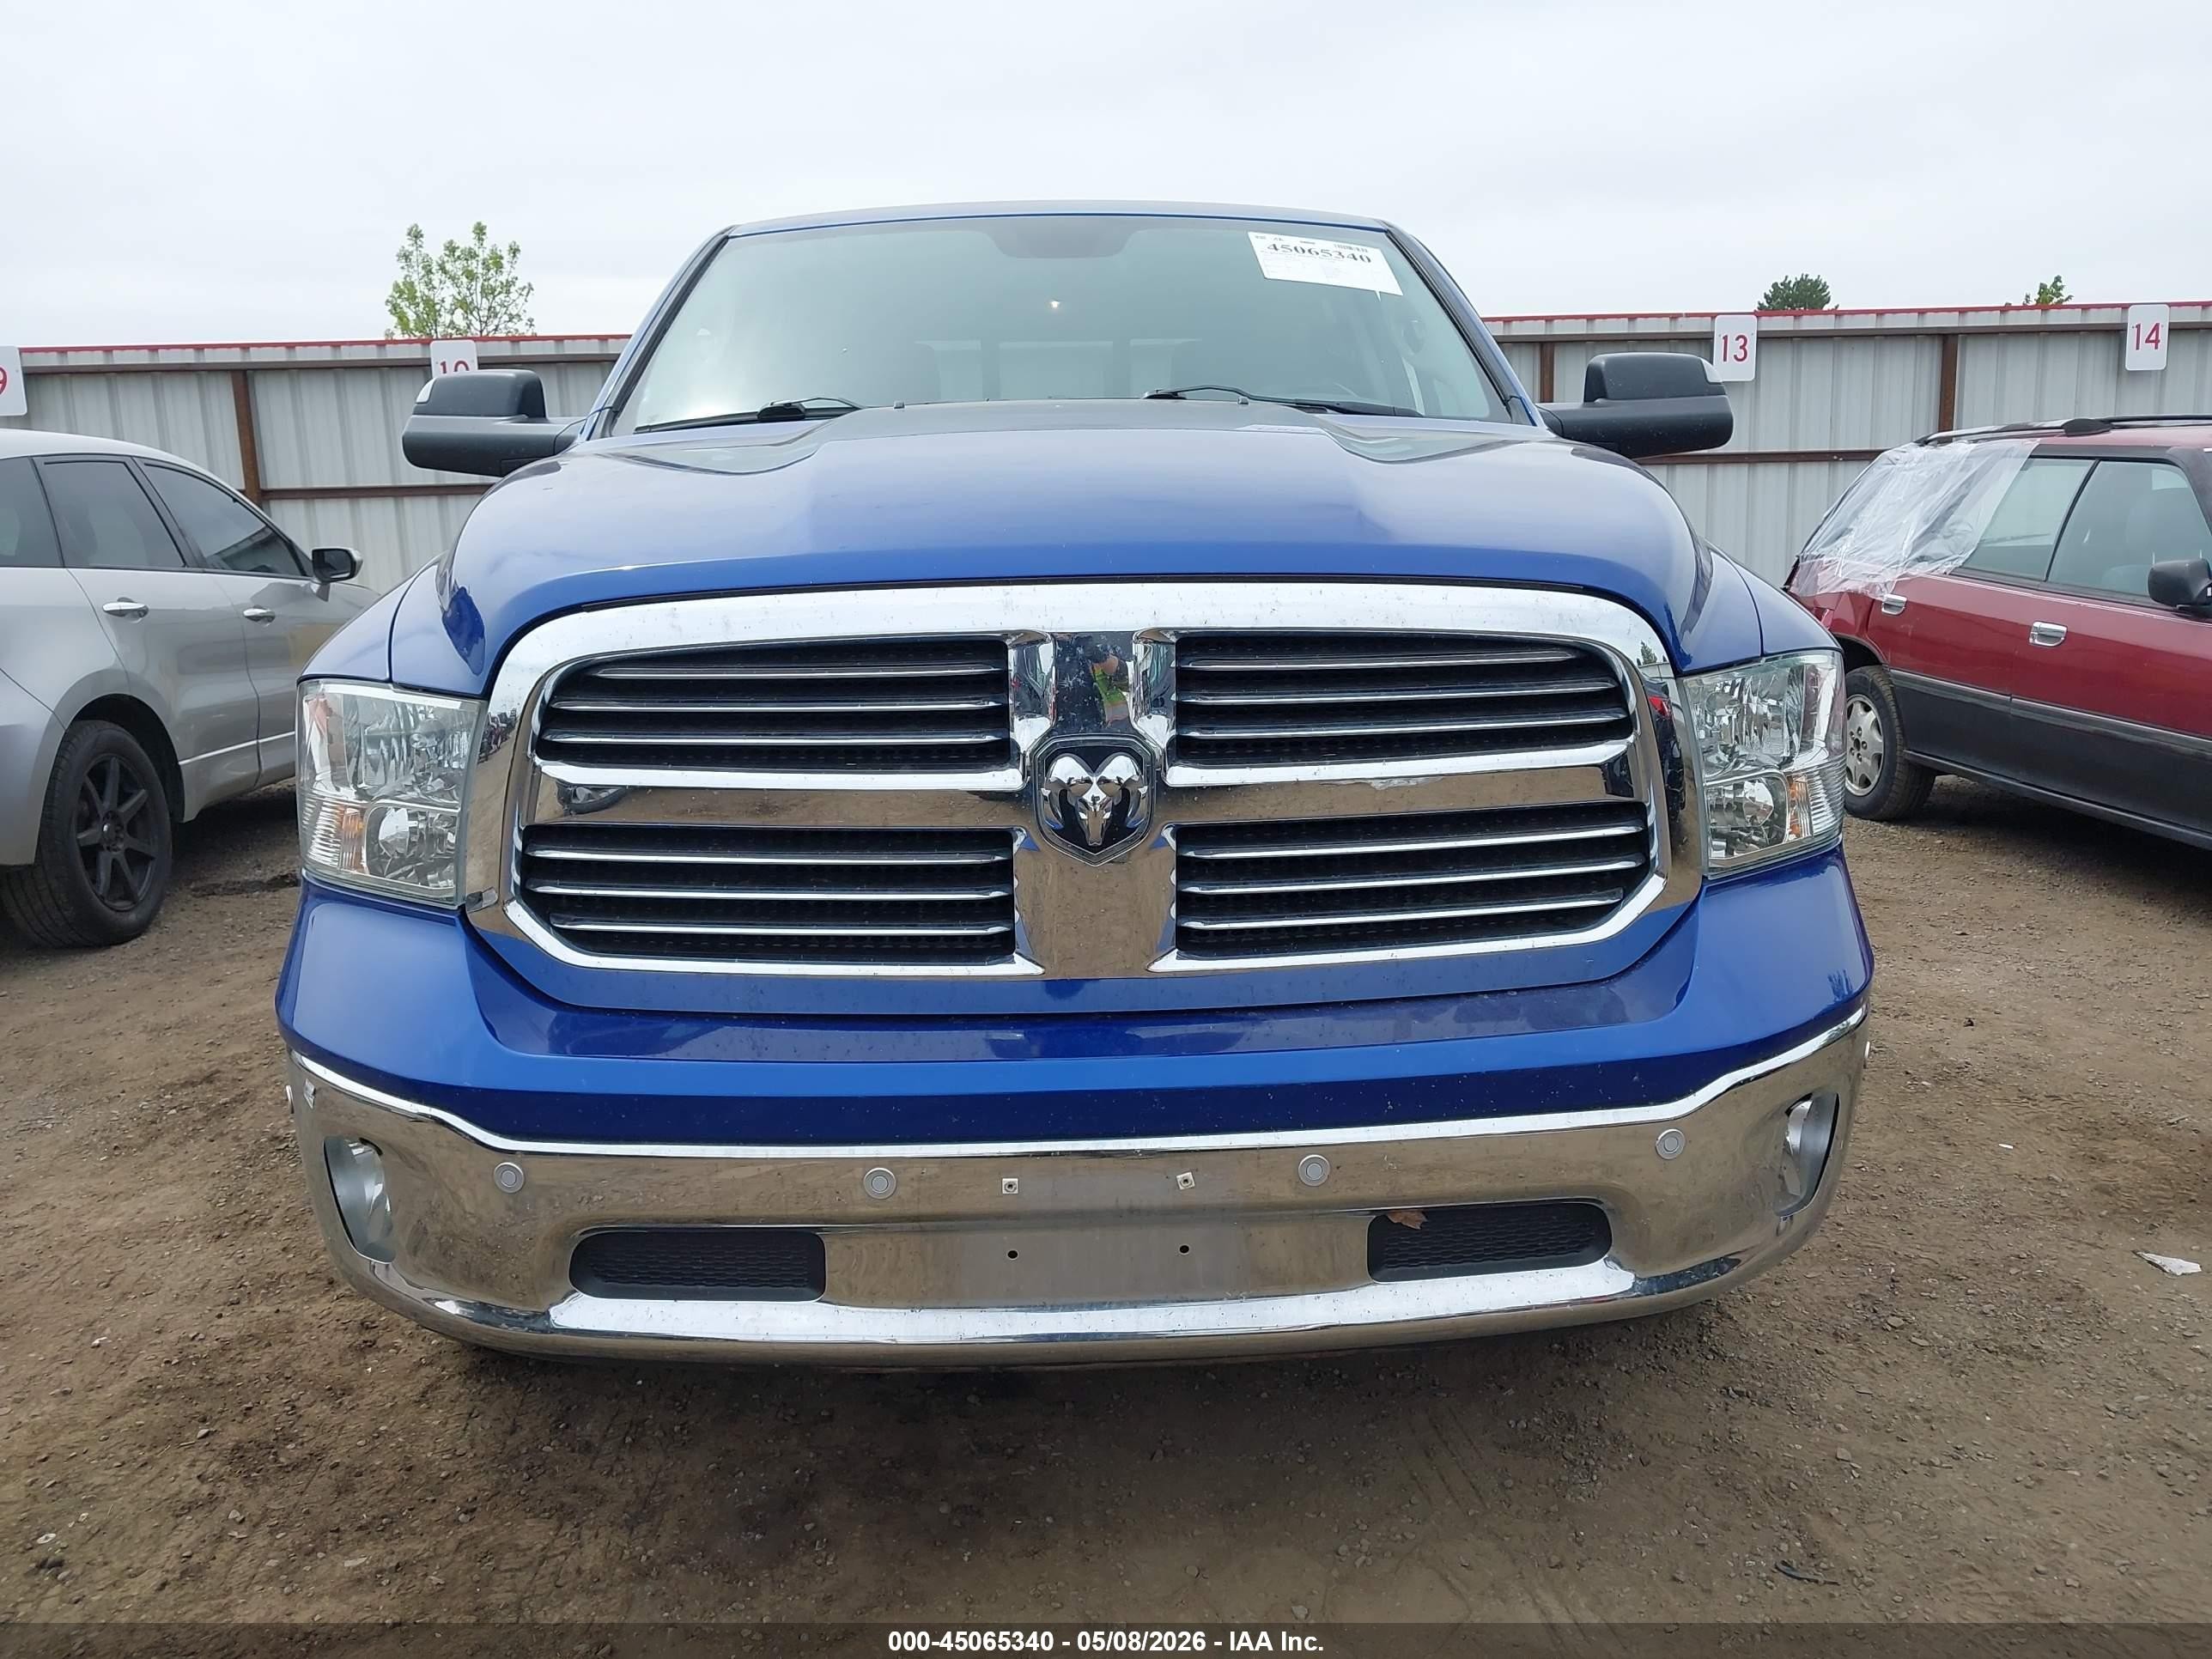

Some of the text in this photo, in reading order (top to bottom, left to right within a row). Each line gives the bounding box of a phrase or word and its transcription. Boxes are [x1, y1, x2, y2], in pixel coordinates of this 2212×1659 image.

[1267, 243, 1371, 263] 45065340
[1723, 334, 1748, 362] 13
[2135, 322, 2160, 350] 14
